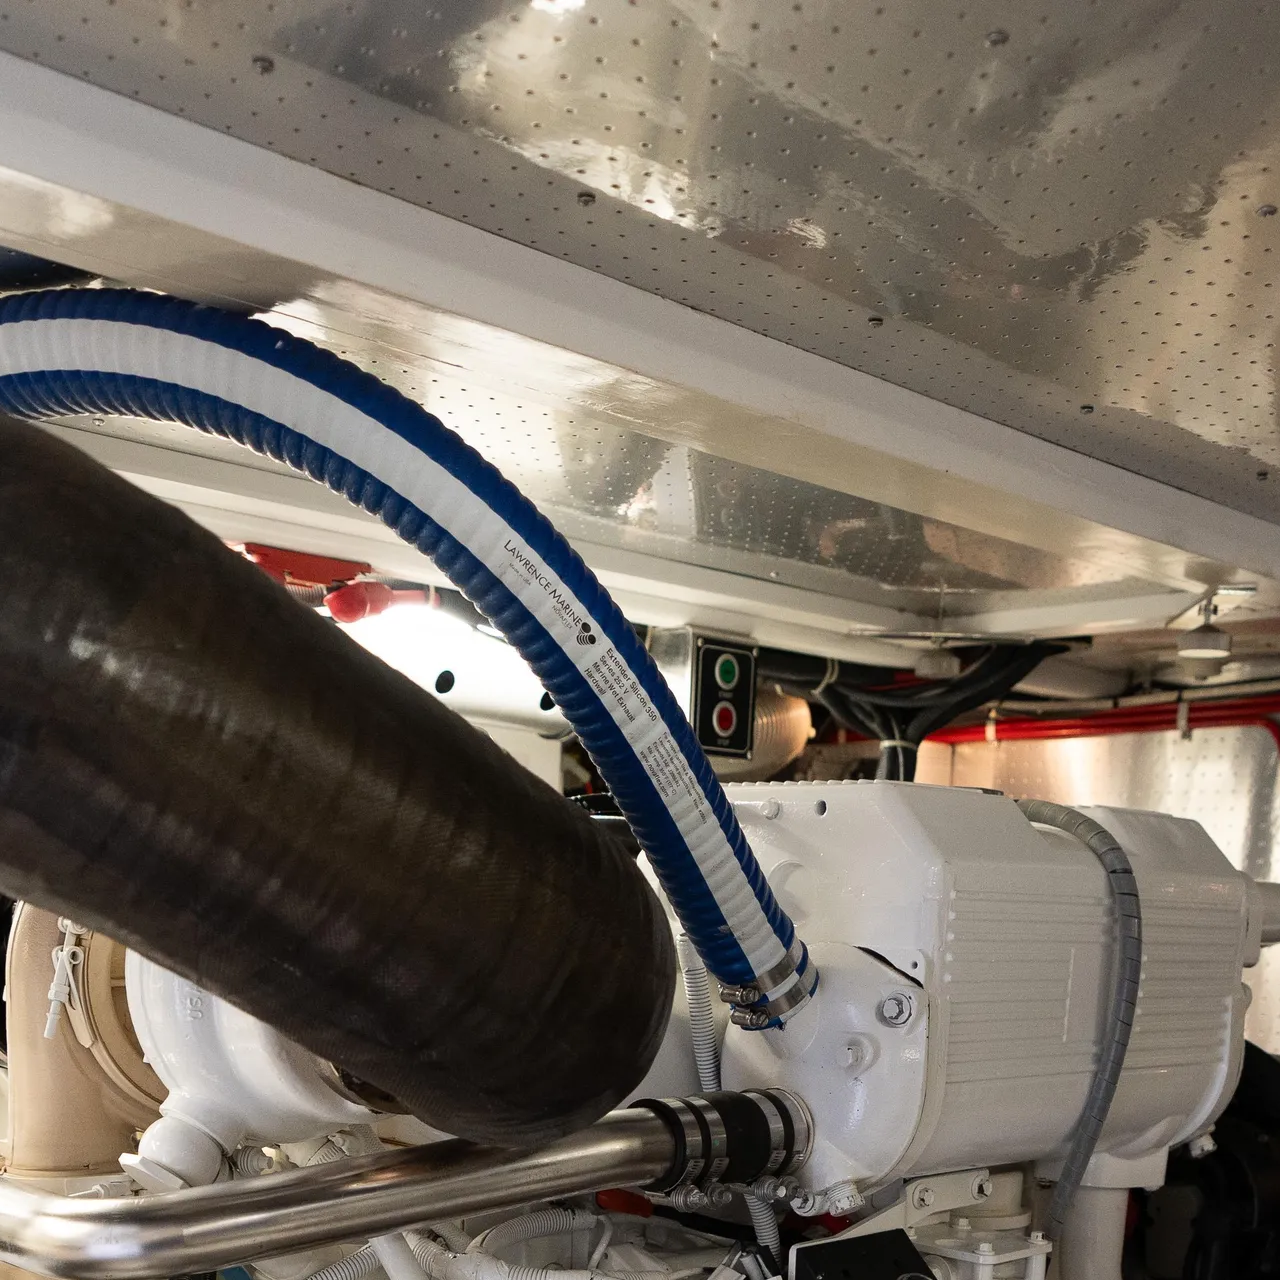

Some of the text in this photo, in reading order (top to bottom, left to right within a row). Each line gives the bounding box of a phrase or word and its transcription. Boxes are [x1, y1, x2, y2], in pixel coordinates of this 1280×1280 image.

[503, 539, 583, 627] LAWRENCE MARINE
[591, 661, 635, 722] Marine Wet Exhaust
[598, 655, 629, 695] Series 252 V
[605, 647, 657, 721] Extender Silicon 350
